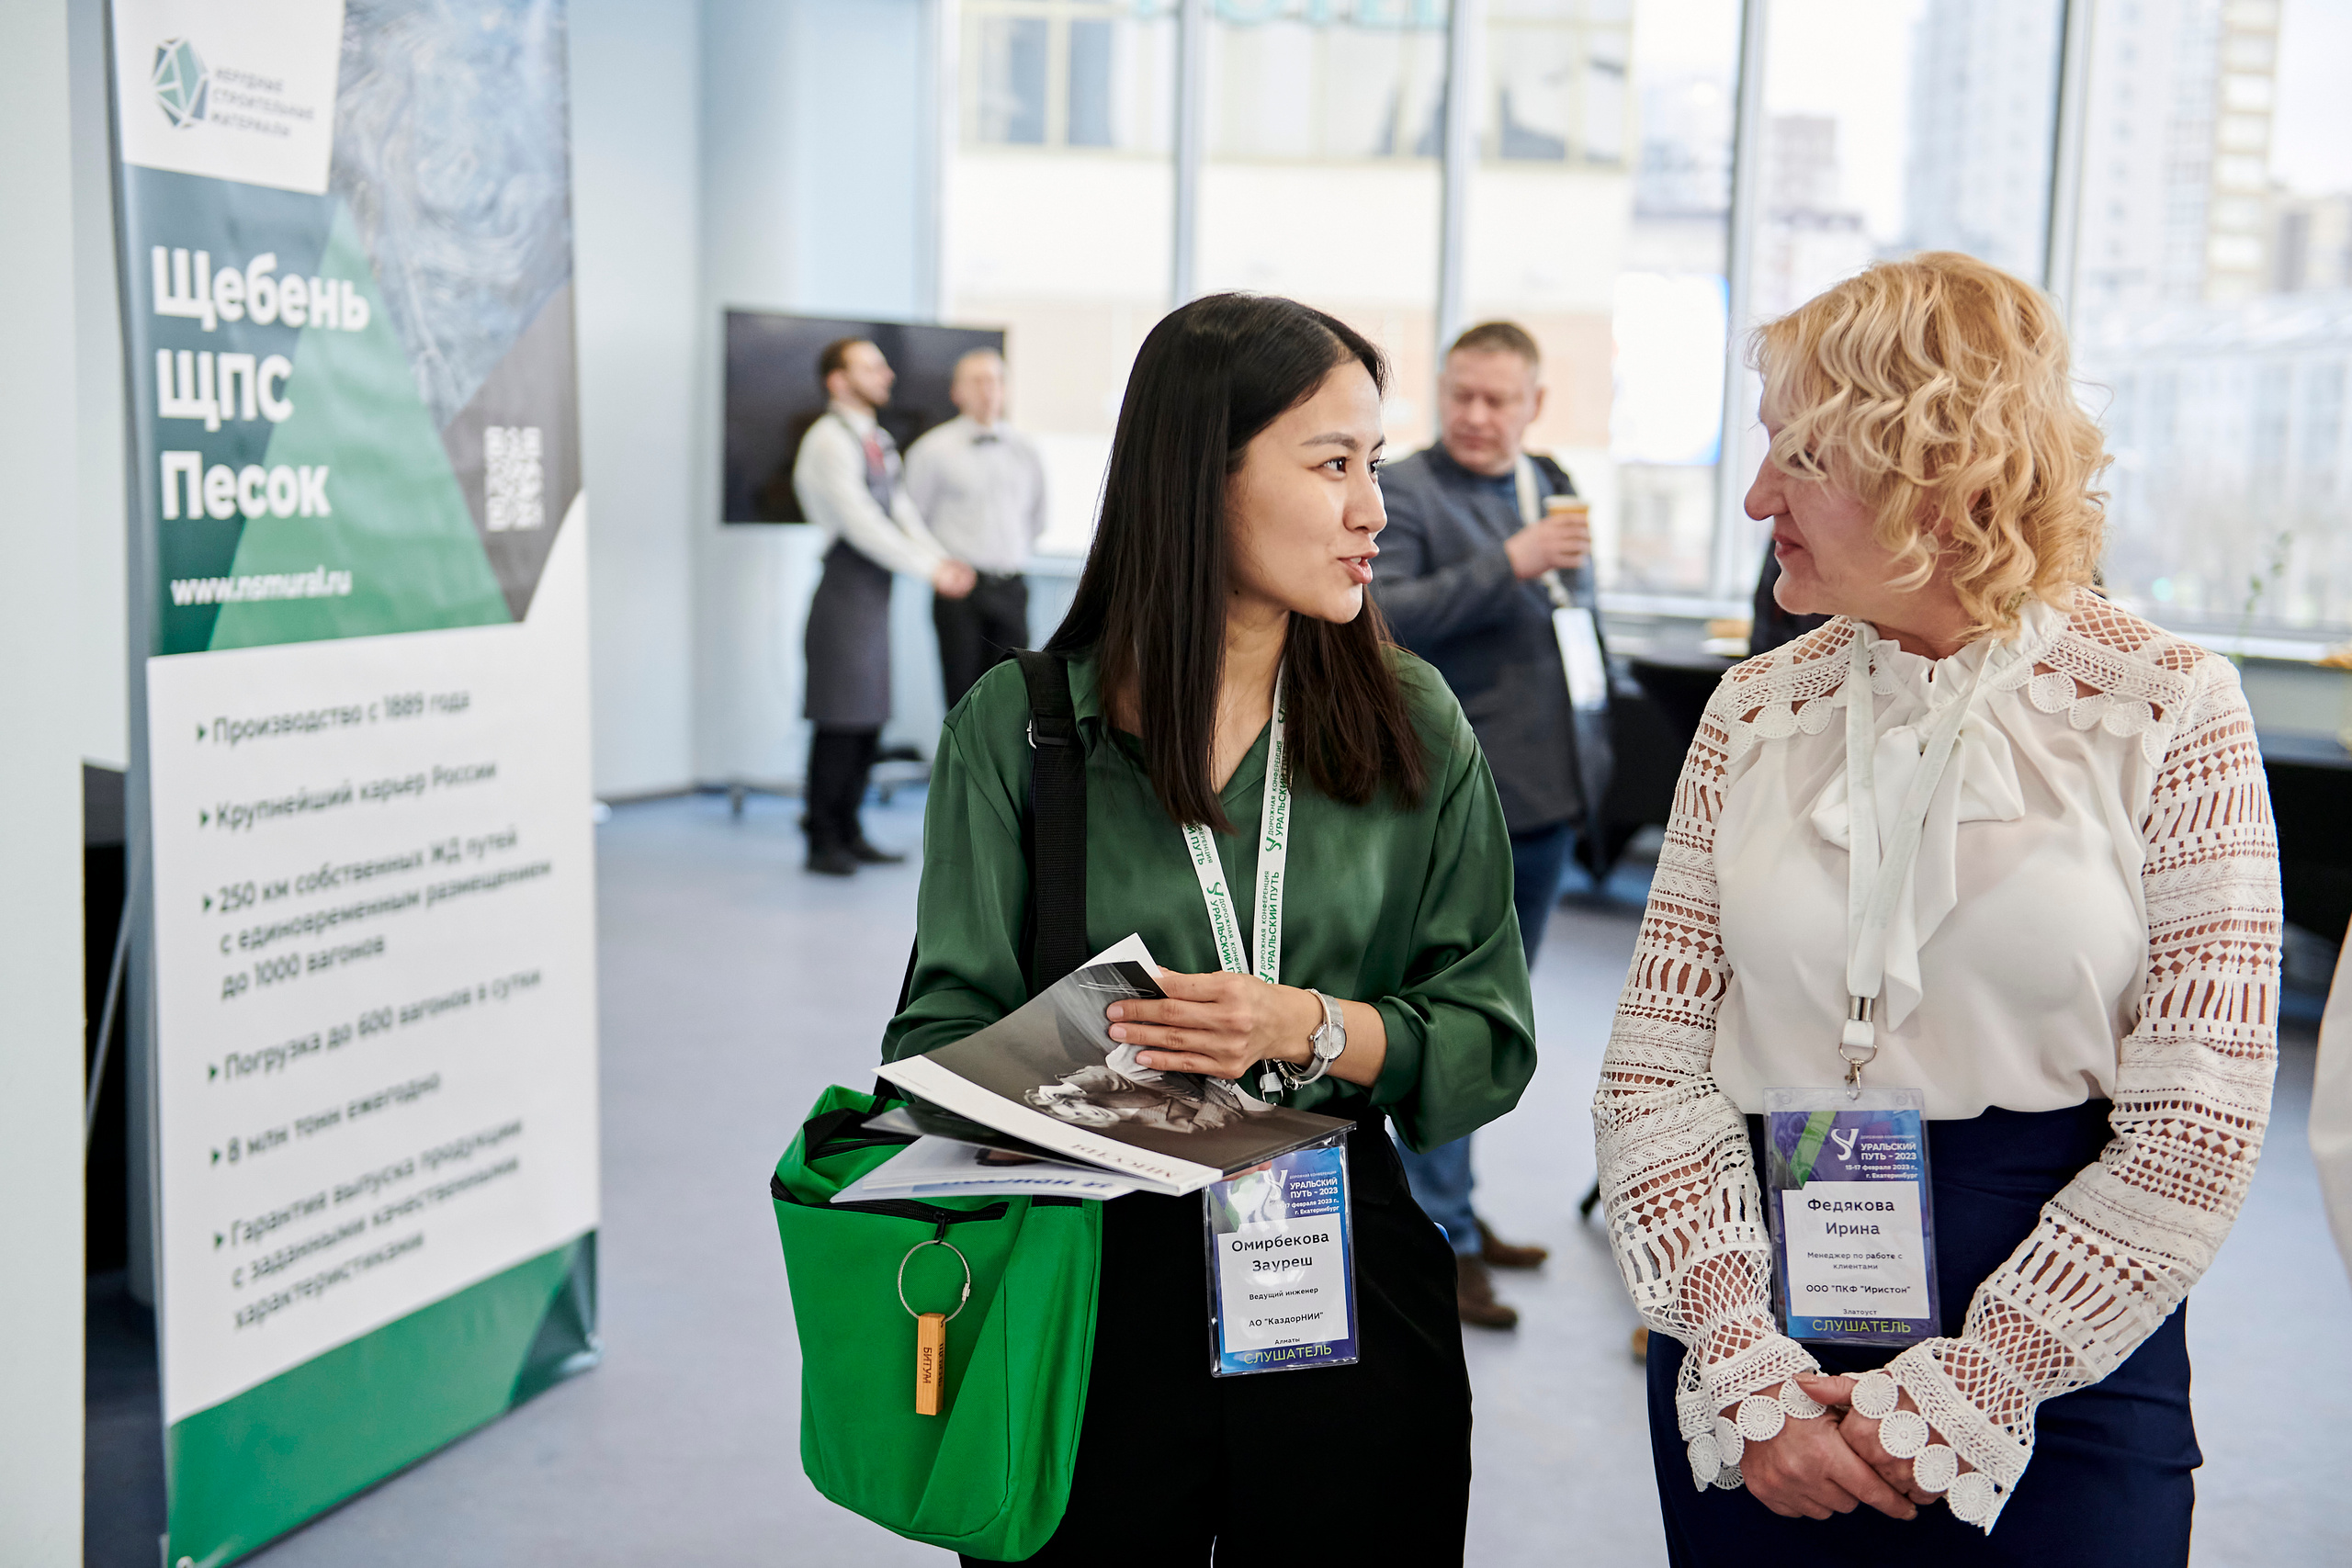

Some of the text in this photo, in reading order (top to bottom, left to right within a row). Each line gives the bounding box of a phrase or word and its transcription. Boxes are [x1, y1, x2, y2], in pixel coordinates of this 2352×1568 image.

[152, 244, 370, 333] Щебень
[156, 347, 295, 432] ЩПС
[160, 450, 332, 521] Песок
[213, 691, 470, 748] Производство с 1889 года
[216, 761, 497, 832] Крупнейший карьер России
[1268, 740, 1282, 836] ДОРОЖНАЯ КОНФЕРЕНЦИЯ
[219, 826, 517, 912] 250 км собственных ЖД путей
[1191, 836, 1204, 865] ПУТЬ
[1261, 871, 1270, 924] КОНФЕРЕНЦИЯ
[1270, 872, 1280, 901] ПУТЬ
[220, 860, 552, 954] с единовременным размещением
[1218, 897, 1234, 939] ДОРОЖНАЯ
[1210, 899, 1233, 965] УРАЛЬСКИЙ
[1267, 904, 1278, 971] УРАЛЬСКИЙ
[220, 935, 385, 1001] до 1000 вагонов
[225, 968, 540, 1079] Погрузка до 600 вагонов в сутки
[227, 1071, 441, 1165] 8 млн тонн ежегодно
[1860, 1142, 1917, 1151] УРАЛЬСКИЙ
[231, 1118, 523, 1247] Гарантия выпуска продукции
[1290, 1177, 1338, 1190] УРАЛЬСКИЙ
[1291, 1190, 1313, 1199] ПУТЬ
[1319, 1187, 1338, 1195] 2023
[232, 1156, 519, 1290] с заданными качественными
[1292, 1201, 1317, 1209] февраля
[1300, 1206, 1340, 1214] Екатеринбург
[1807, 1198, 1894, 1213] Федякова
[1232, 1233, 1329, 1252] Омирбекова
[1826, 1223, 1880, 1237] Ирина
[1252, 1257, 1313, 1273] Зауреш
[1807, 1252, 1850, 1260] Менеджер
[1866, 1252, 1895, 1260] работе
[234, 1232, 424, 1329] характеристиками
[1249, 1287, 1318, 1301] Ведущий инженер
[1806, 1284, 1911, 1294] ООО "ПКФ "Иристон"
[1249, 1312, 1324, 1327] АО "КаздорНИИ"
[1813, 1319, 1911, 1333] СЛУШАТЕЛЬ
[923, 1347, 933, 1384] БИТУМ
[1244, 1345, 1332, 1364] СЛУШАТЕЛЬ
